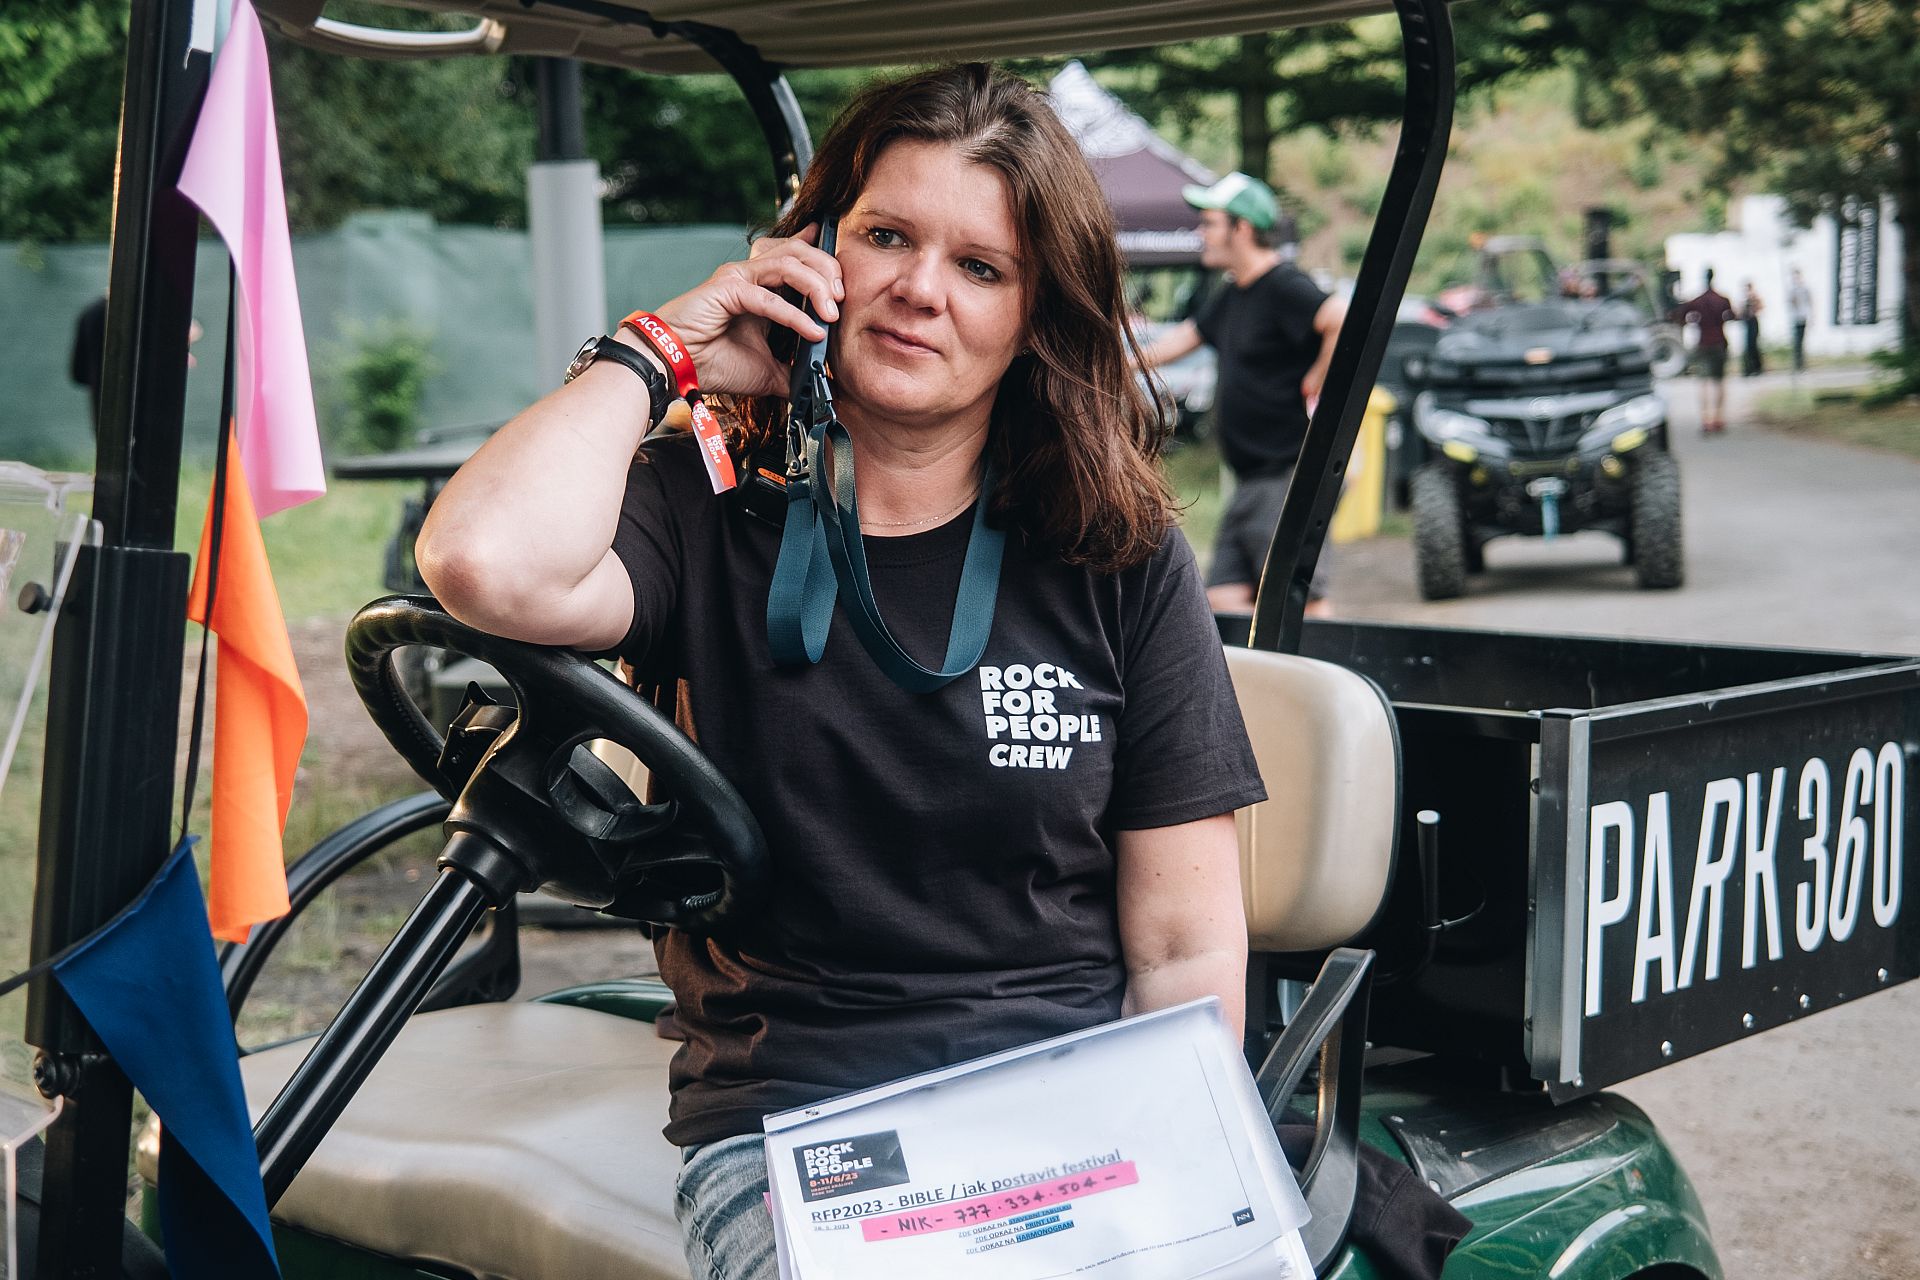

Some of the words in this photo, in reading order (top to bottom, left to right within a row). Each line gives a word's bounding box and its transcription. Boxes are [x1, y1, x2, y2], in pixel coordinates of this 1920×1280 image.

[635, 316, 684, 364] ACCESS
[705, 438, 721, 464] PEOPLE
[709, 436, 720, 451] FOR
[713, 434, 726, 456] ROCK
[978, 662, 1084, 691] ROCK
[981, 689, 1058, 715] FOR
[985, 714, 1102, 743] PEOPLE
[988, 743, 1073, 770] CREW
[803, 1141, 855, 1160] ROCK
[805, 1154, 842, 1169] FOR
[807, 1156, 874, 1178] PEOPLE
[811, 1199, 883, 1222] RFP2023
[898, 1188, 945, 1208] BIBLE
[950, 1183, 956, 1201] /
[961, 1179, 987, 1199] jak
[991, 1166, 1059, 1194] postavit
[1062, 1148, 1122, 1175] festival
[965, 1247, 979, 1255] ZDE
[979, 1240, 1004, 1253] ODKAZ
[1004, 1237, 1016, 1247] NA
[1015, 1220, 1075, 1243] HARMONOGRAM
[972, 1223, 996, 1235] ODKAZ
[997, 1220, 1008, 1229] NA
[975, 1236, 988, 1244] ZDE
[988, 1228, 1012, 1240] ODKAZ
[1013, 1225, 1025, 1233] NA
[1025, 1218, 1045, 1231] PRINT
[1046, 1214, 1060, 1224] LIST
